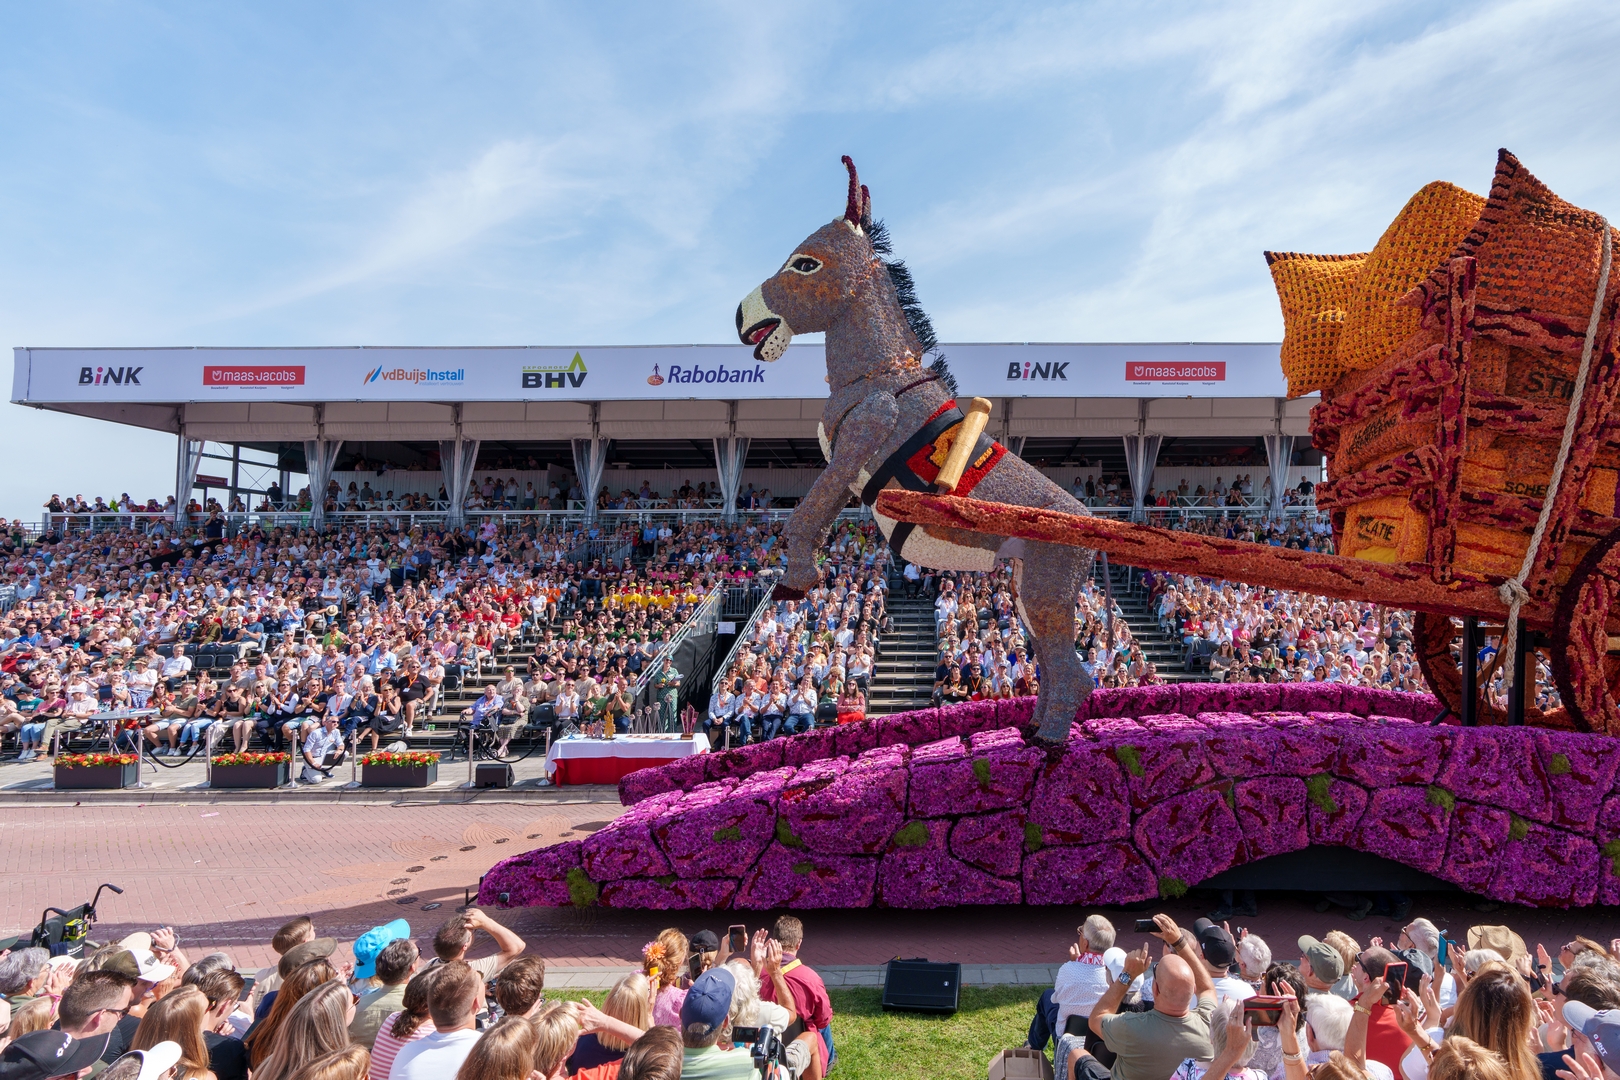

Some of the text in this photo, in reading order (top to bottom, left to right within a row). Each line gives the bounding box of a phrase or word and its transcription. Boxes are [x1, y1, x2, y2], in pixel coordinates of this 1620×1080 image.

[522, 372, 588, 388] BHV
[667, 364, 766, 383] Rabobank
[1504, 481, 1550, 496] SCHE
